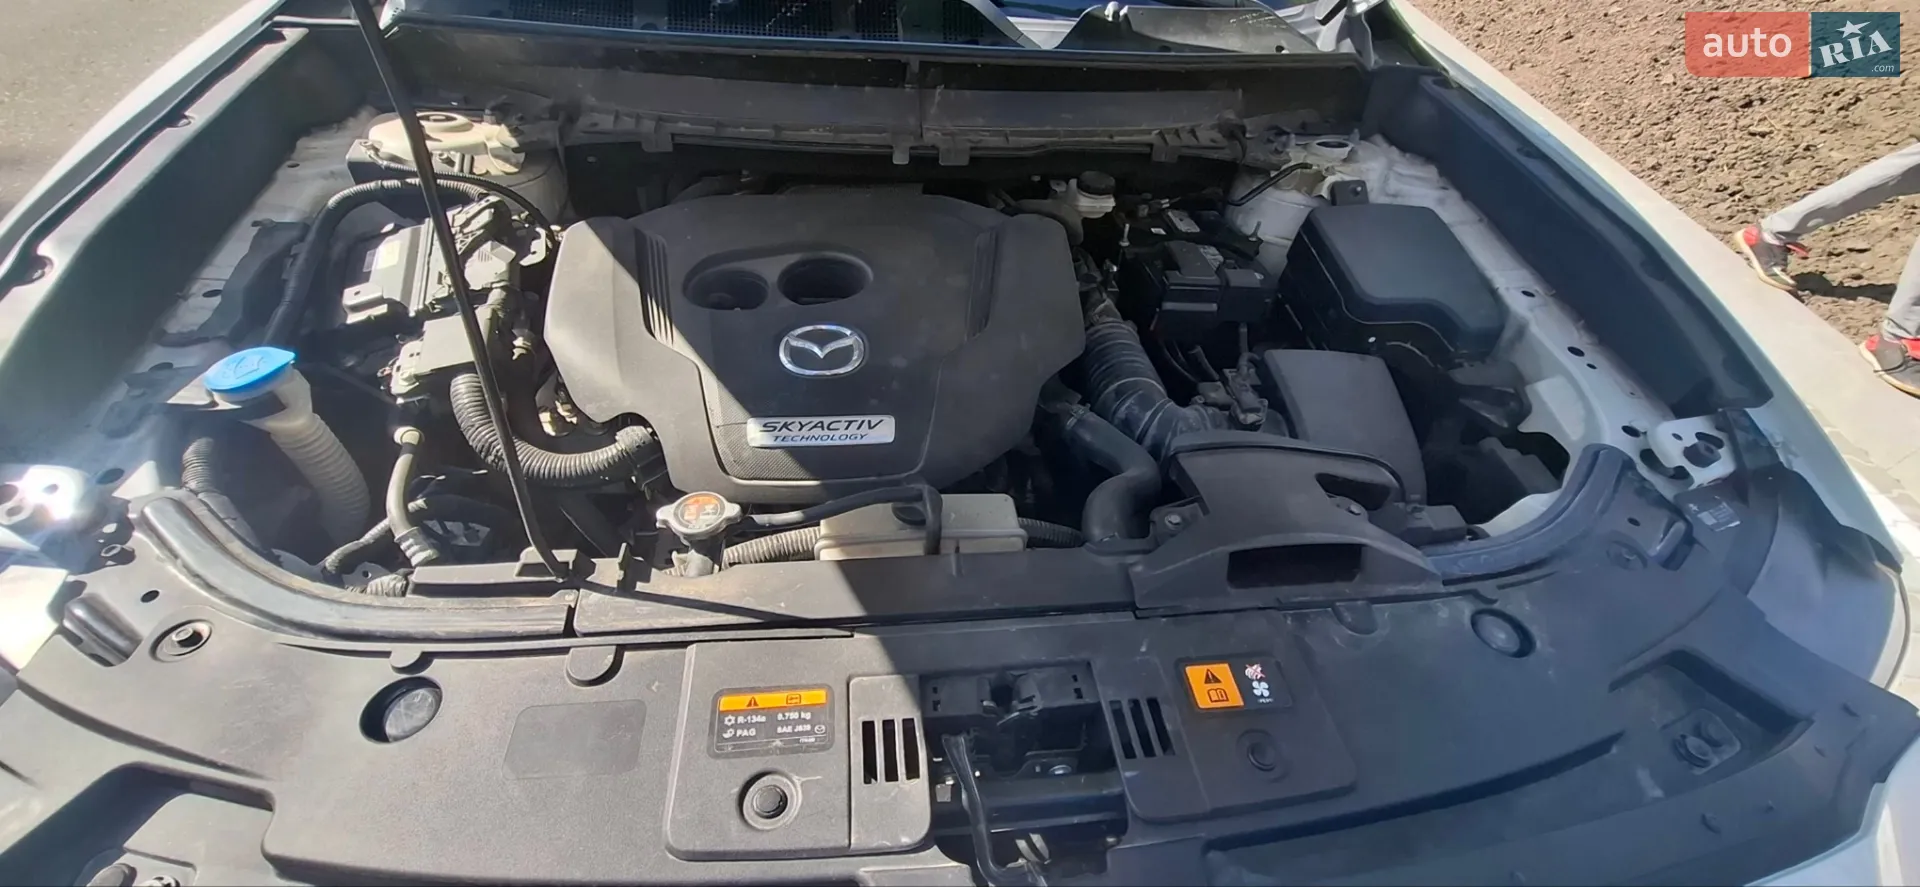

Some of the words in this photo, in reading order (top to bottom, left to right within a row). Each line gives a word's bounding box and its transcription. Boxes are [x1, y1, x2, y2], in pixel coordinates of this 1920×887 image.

[760, 419, 884, 432] SKYACTIV
[772, 433, 868, 442] TECHNOLOGY
[801, 711, 811, 720] kg
[736, 728, 756, 737] PAG
